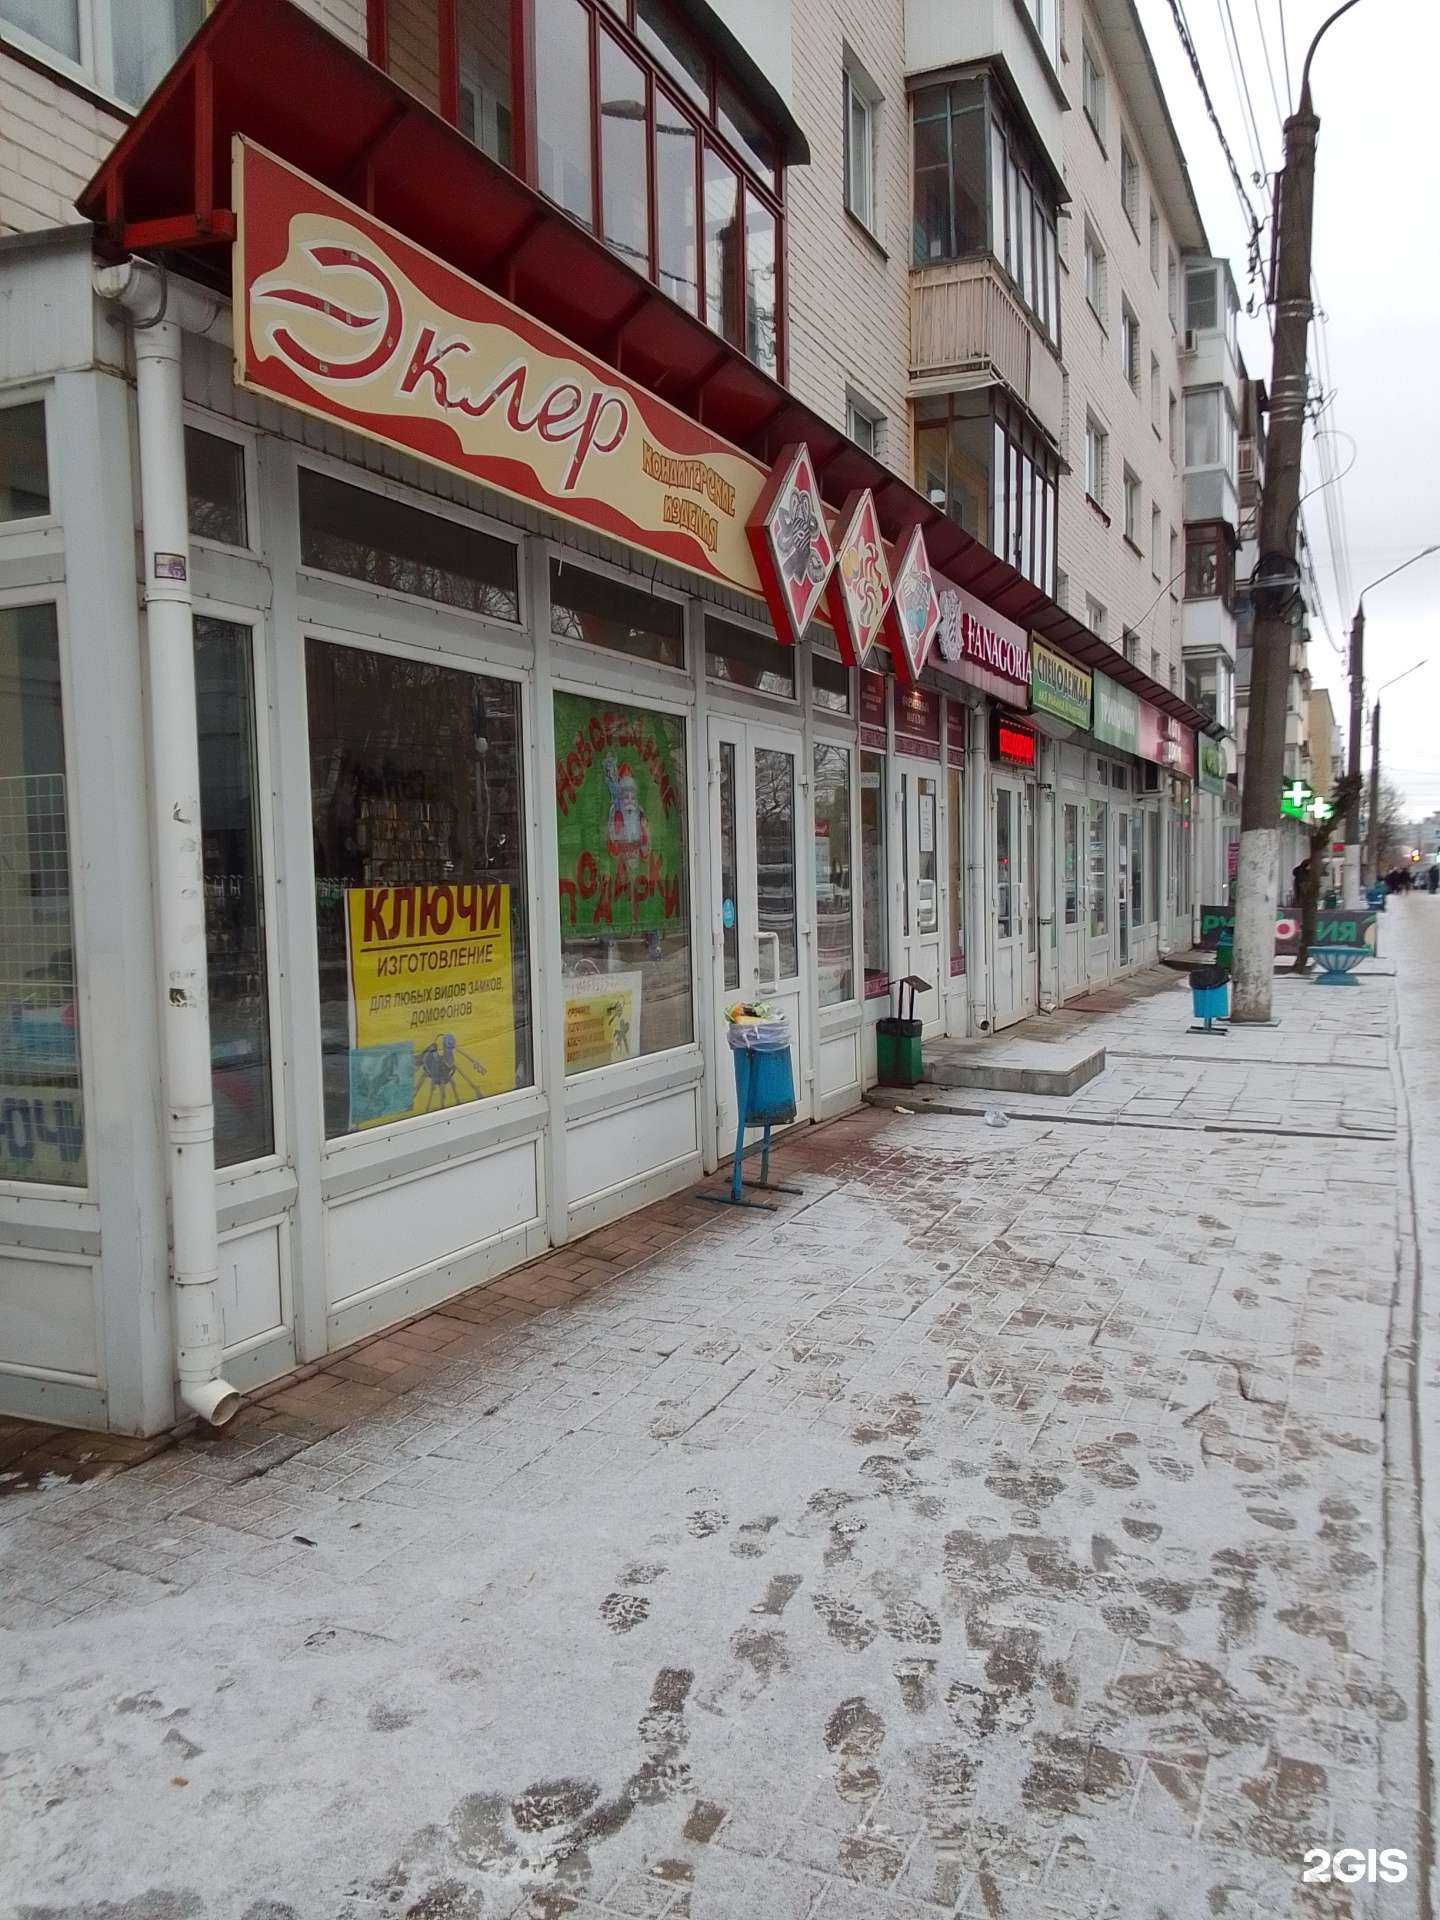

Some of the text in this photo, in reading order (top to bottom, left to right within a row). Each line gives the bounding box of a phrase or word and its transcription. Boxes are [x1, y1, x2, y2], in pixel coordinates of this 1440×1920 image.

[251, 242, 630, 491] Эклер
[642, 439, 736, 518] КОНДИТЕРСКИЕ
[663, 495, 719, 553] ИЗДЕЛИЯ
[967, 613, 1033, 685] FANAGORIA
[1037, 652, 1090, 705] СПЕЦОДЕЖДА
[363, 884, 501, 942] КЛЮЧИ
[558, 852, 679, 924] ПОДАРКИ
[377, 944, 493, 977] ИЗГОТОВЛЕНИЕ
[369, 994, 391, 1015] ДЛЯ
[394, 987, 432, 1008] ЛЮБЫХ
[434, 982, 466, 1002] ВИДОВ
[410, 1001, 472, 1029] ДОМОФОНОВ
